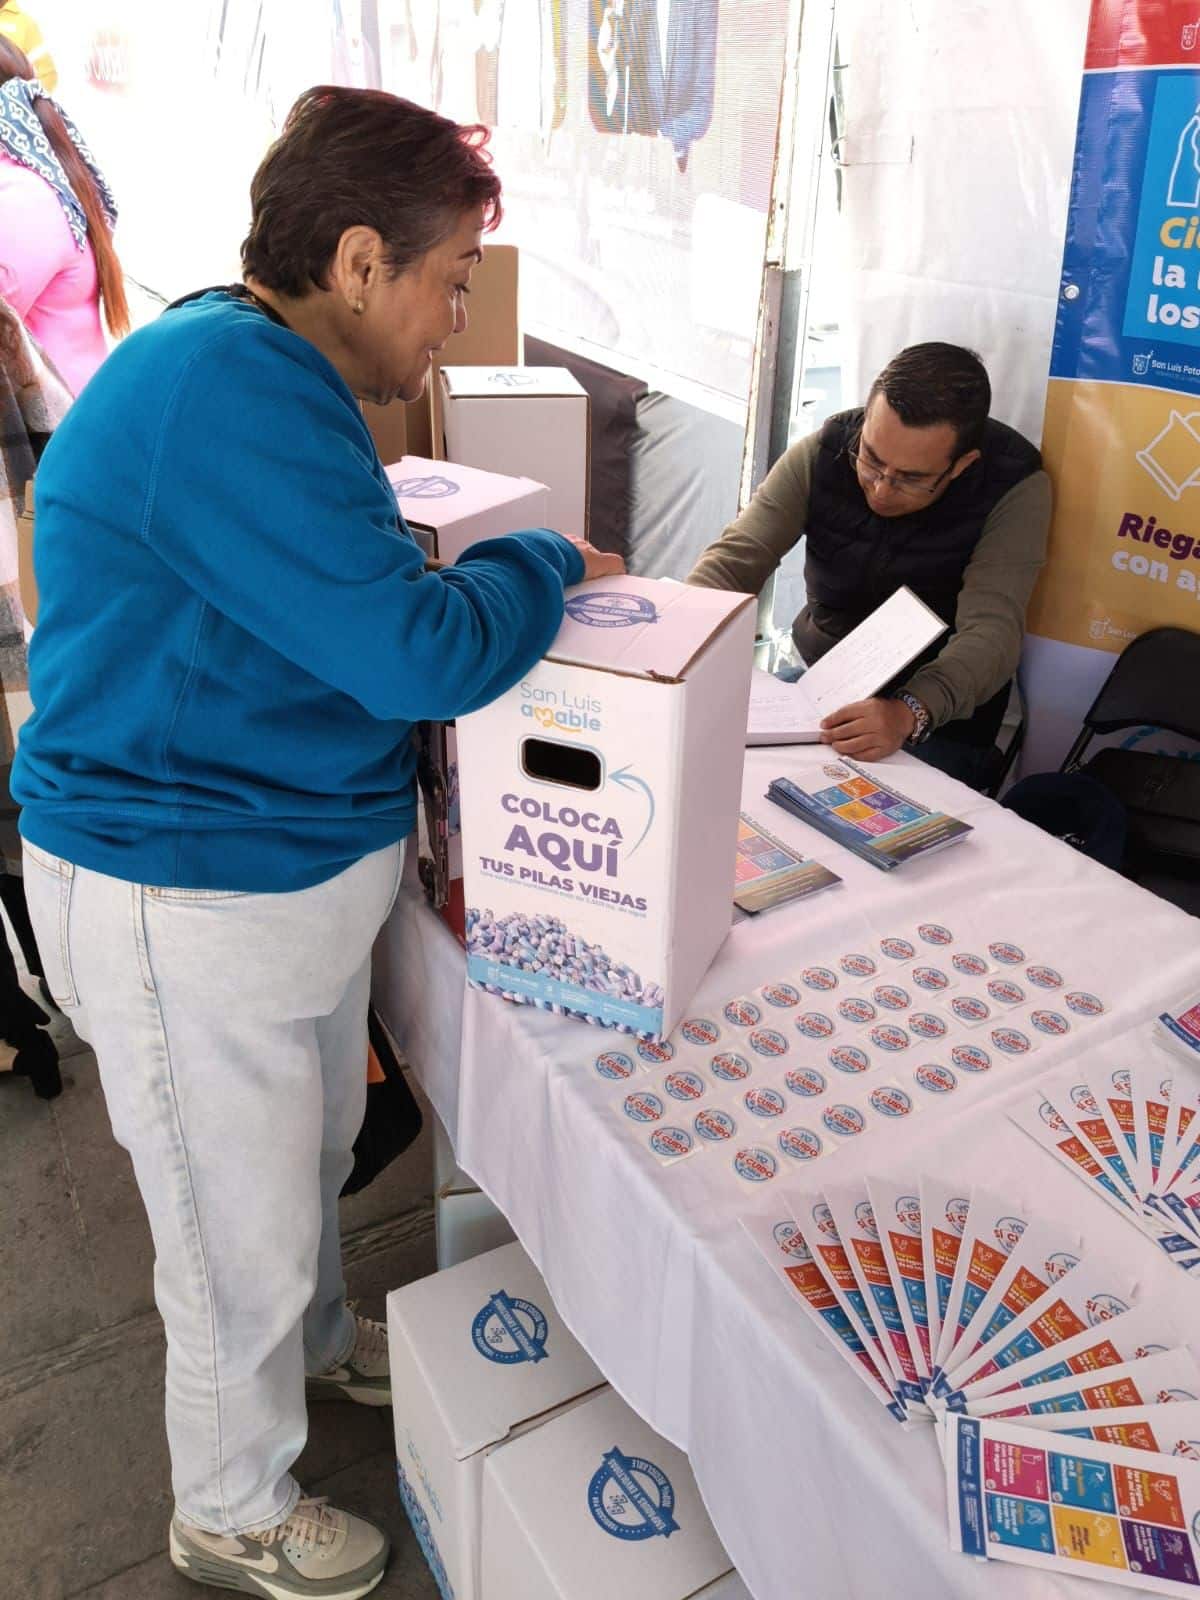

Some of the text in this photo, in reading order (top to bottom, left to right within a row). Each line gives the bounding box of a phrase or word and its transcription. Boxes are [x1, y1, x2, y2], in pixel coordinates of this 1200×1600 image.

[1160, 216, 1200, 249] Ci
[1152, 255, 1186, 289] la
[1147, 293, 1200, 329] los
[1151, 359, 1167, 369] San
[1167, 362, 1182, 373] Luis
[1111, 550, 1200, 600] con a
[520, 681, 602, 713] San Luis
[501, 793, 623, 839] COLOCA
[503, 824, 623, 878] AQUÍ
[479, 857, 515, 876] TUS
[519, 867, 574, 892] PILAS
[578, 881, 648, 911] VIEJAS
[636, 1100, 661, 1121] CUIDO
[755, 1095, 784, 1115] CUIDO
[881, 1094, 909, 1115] CUIDO
[707, 1116, 732, 1138] CUIDO
[834, 1112, 863, 1134] CUIDO
[662, 1135, 689, 1155] CUIDO
[788, 1135, 819, 1158] CUIDO
[745, 1156, 775, 1179] CUIDO
[757, 1153, 769, 1163] YO
